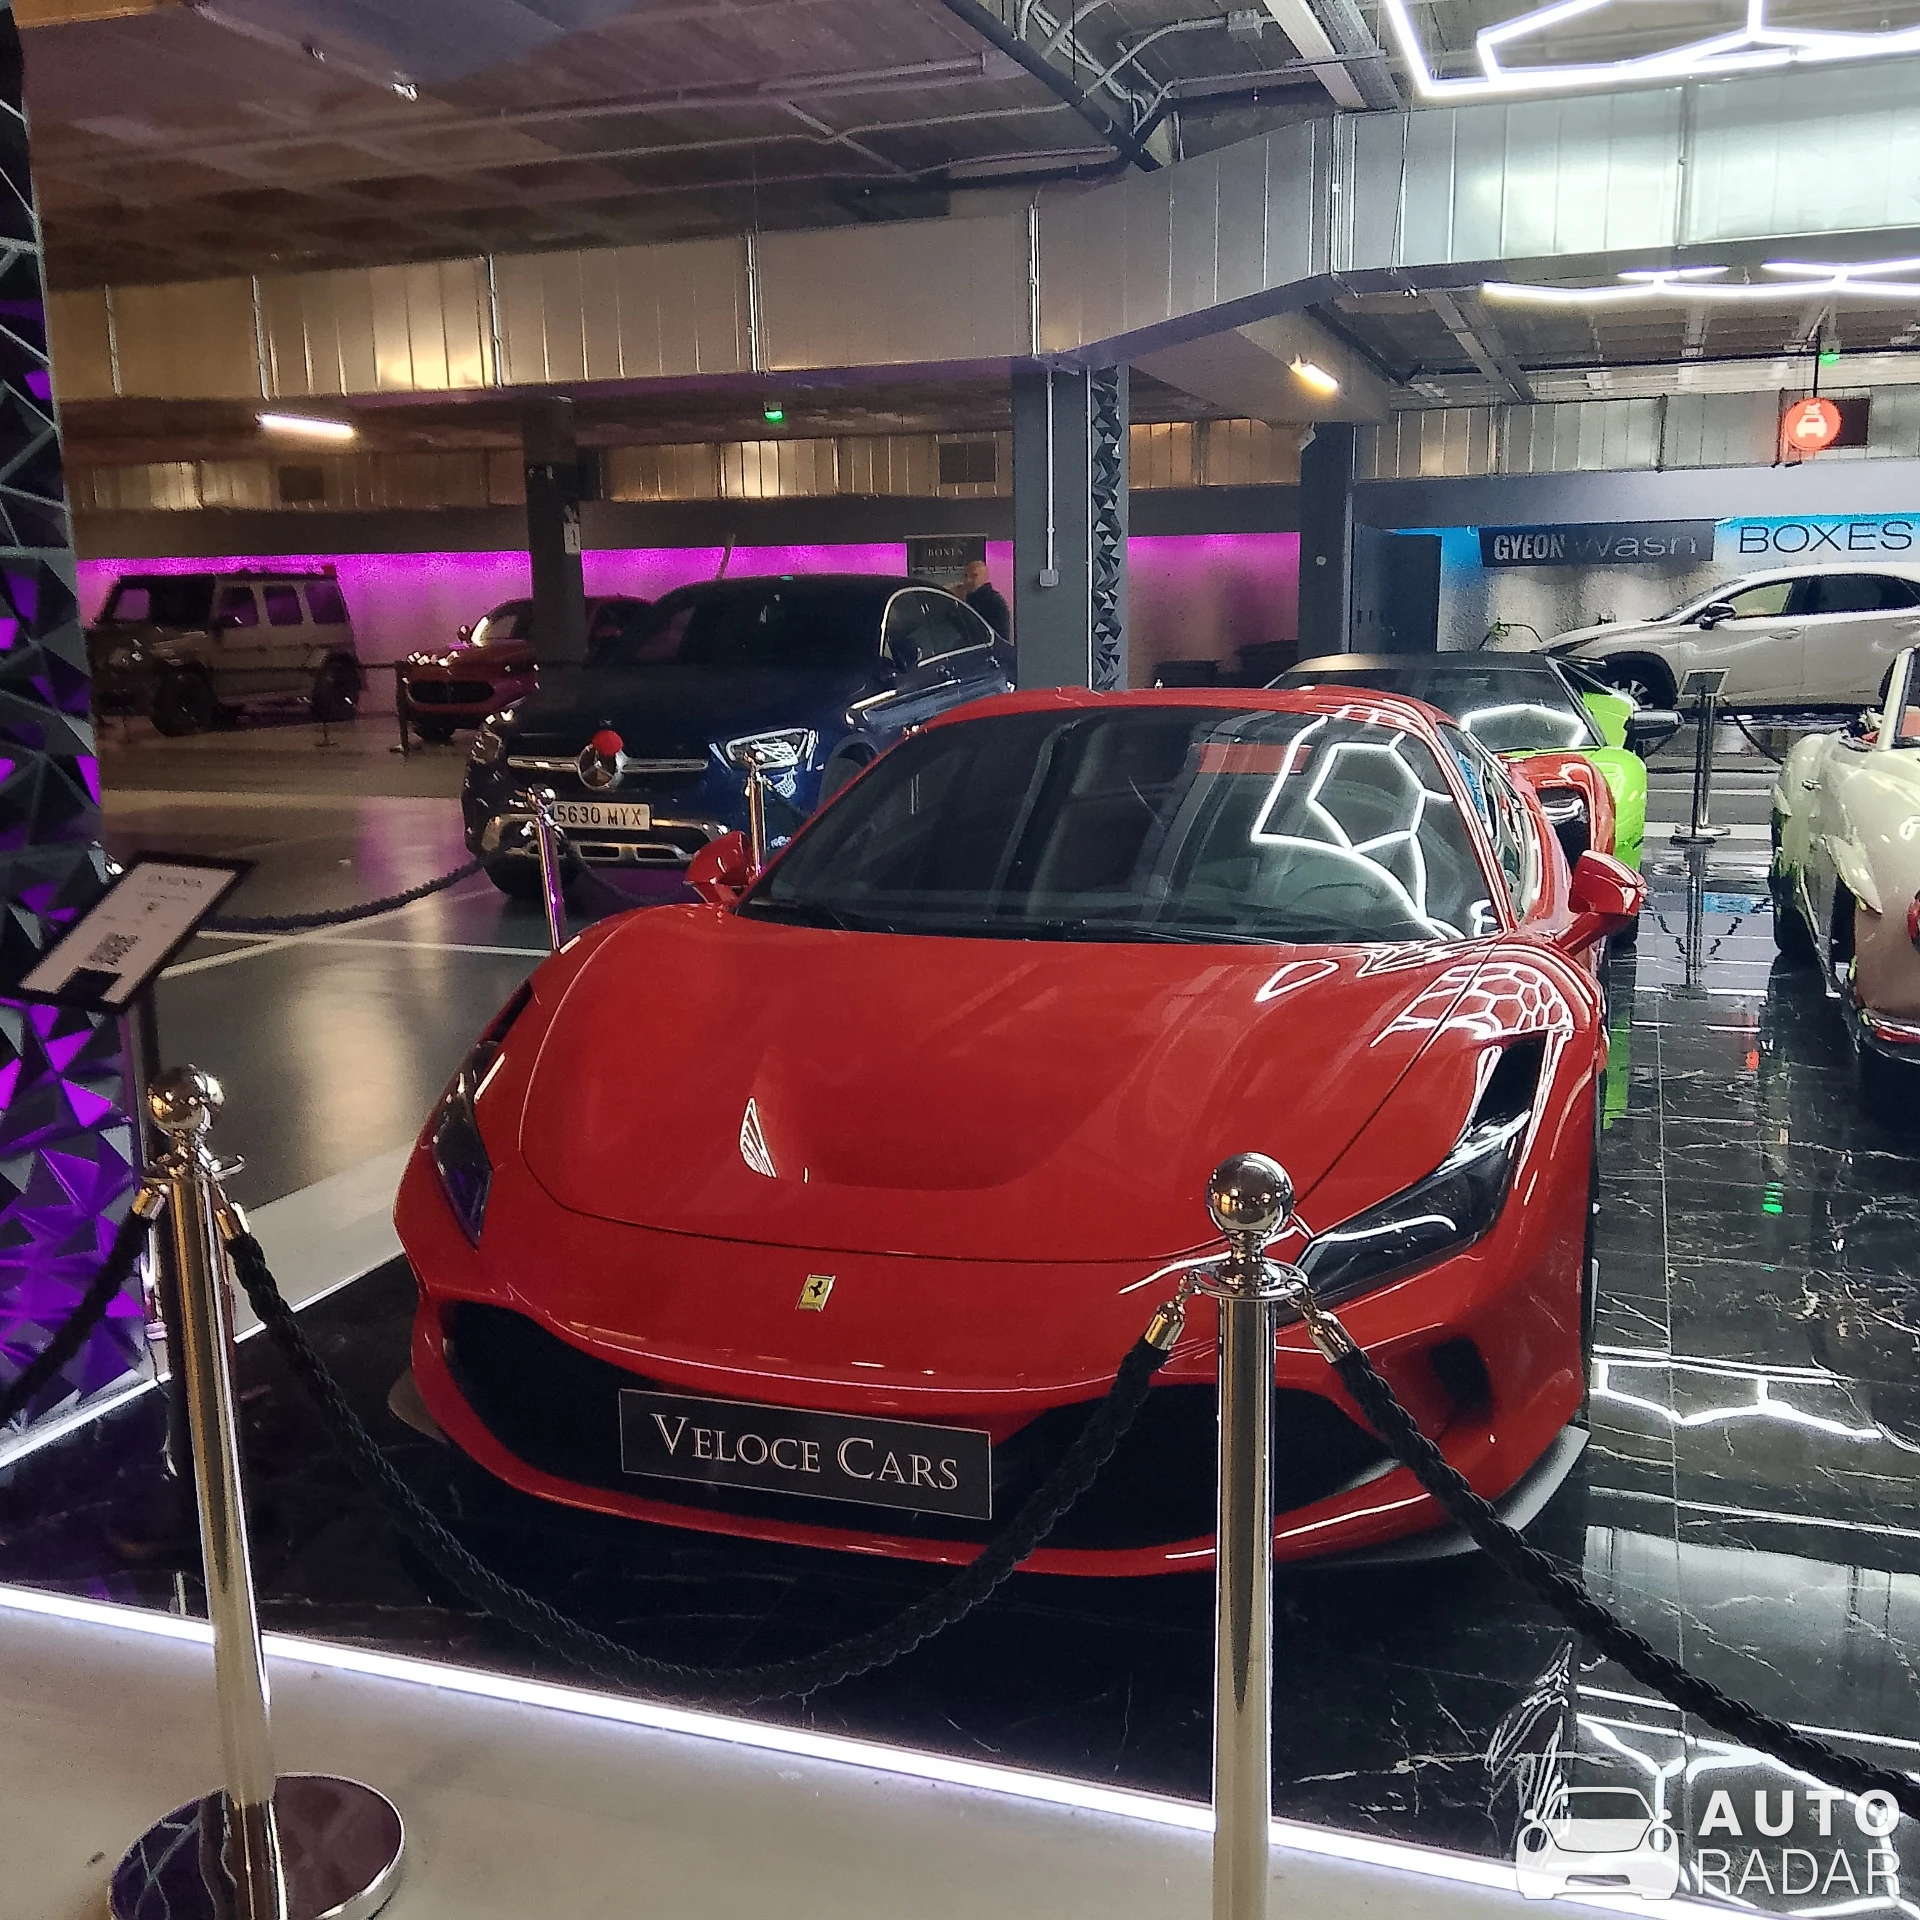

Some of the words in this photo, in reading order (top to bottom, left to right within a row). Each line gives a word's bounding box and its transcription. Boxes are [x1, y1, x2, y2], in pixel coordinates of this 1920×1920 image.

[1493, 532, 1566, 560] GYEON
[1738, 520, 1913, 554] BOXES
[556, 804, 601, 824] 5630
[607, 806, 641, 826] MYX
[650, 1413, 822, 1473] VELOCE
[836, 1436, 959, 1491] CARS
